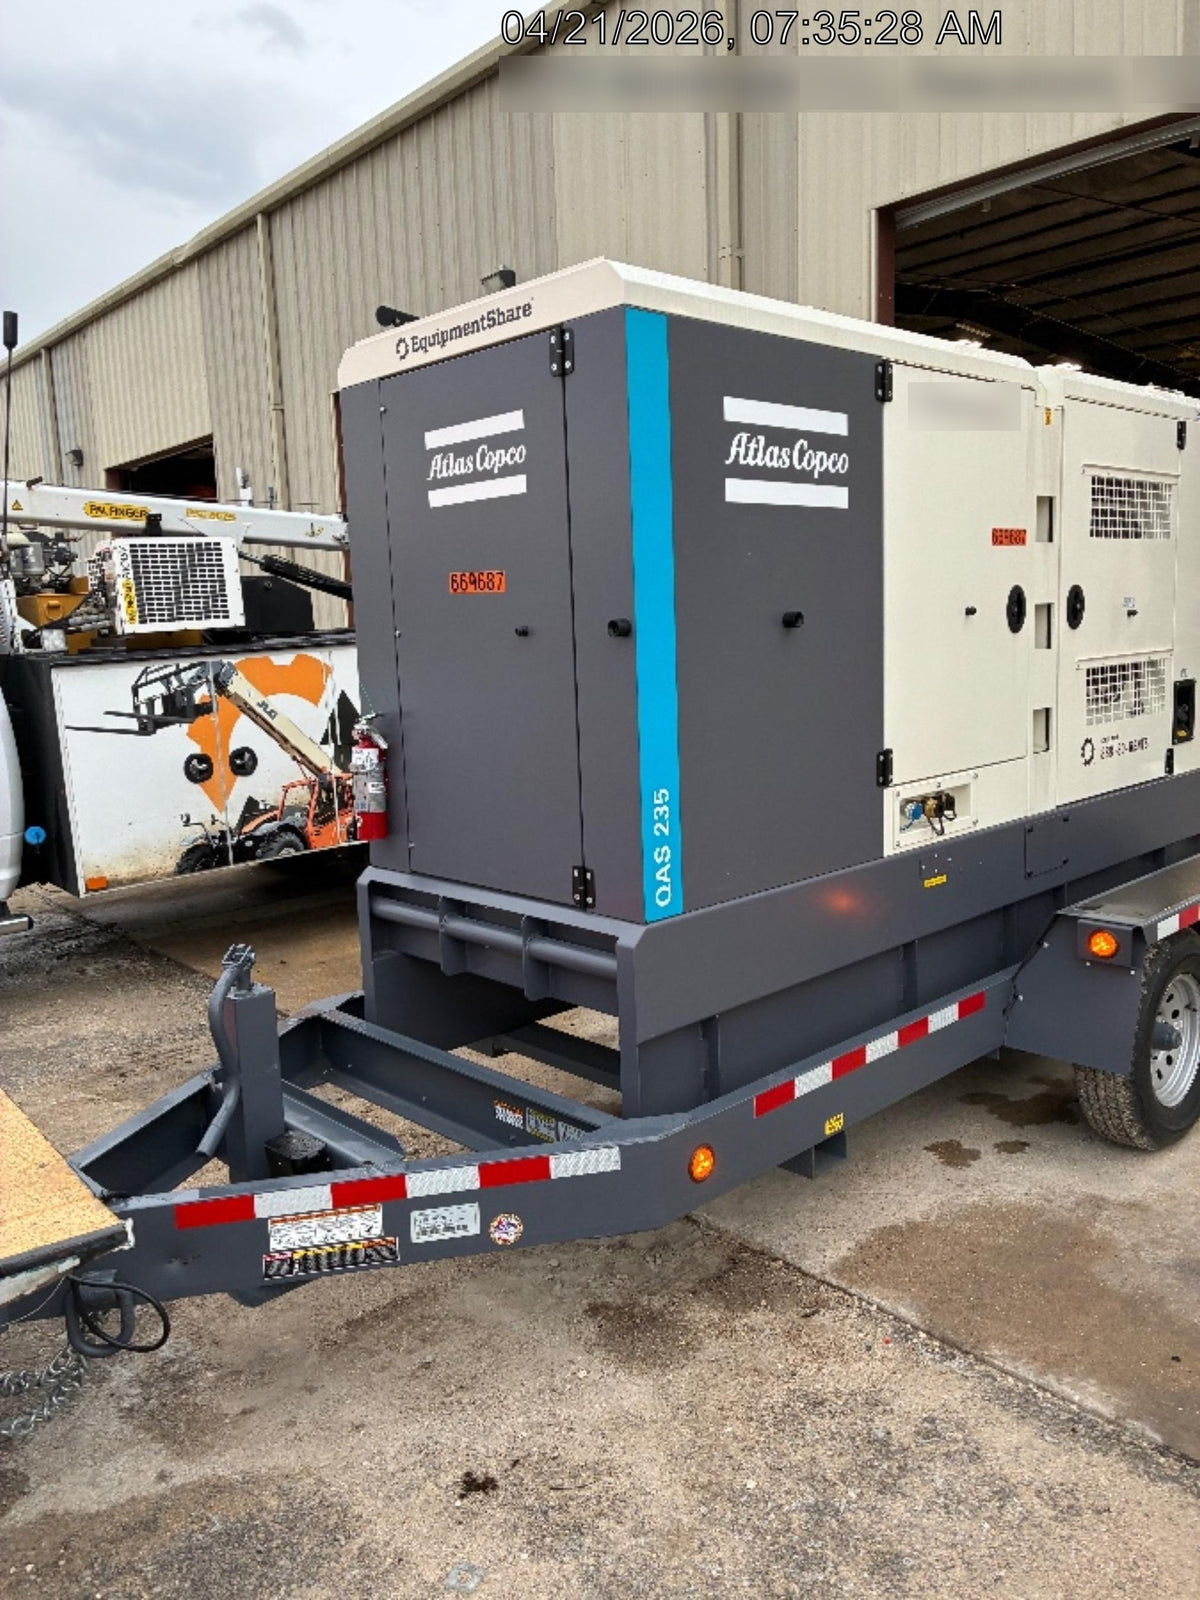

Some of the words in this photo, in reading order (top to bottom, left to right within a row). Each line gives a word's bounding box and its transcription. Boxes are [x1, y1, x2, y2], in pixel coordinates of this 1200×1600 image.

[410, 301, 532, 354] EquipmentShare
[426, 452, 474, 481] Atlas
[476, 444, 527, 473] Copco
[724, 431, 790, 469] Atlas
[792, 438, 849, 479] Copco
[653, 788, 670, 836] 235
[653, 845, 671, 907] QAS
